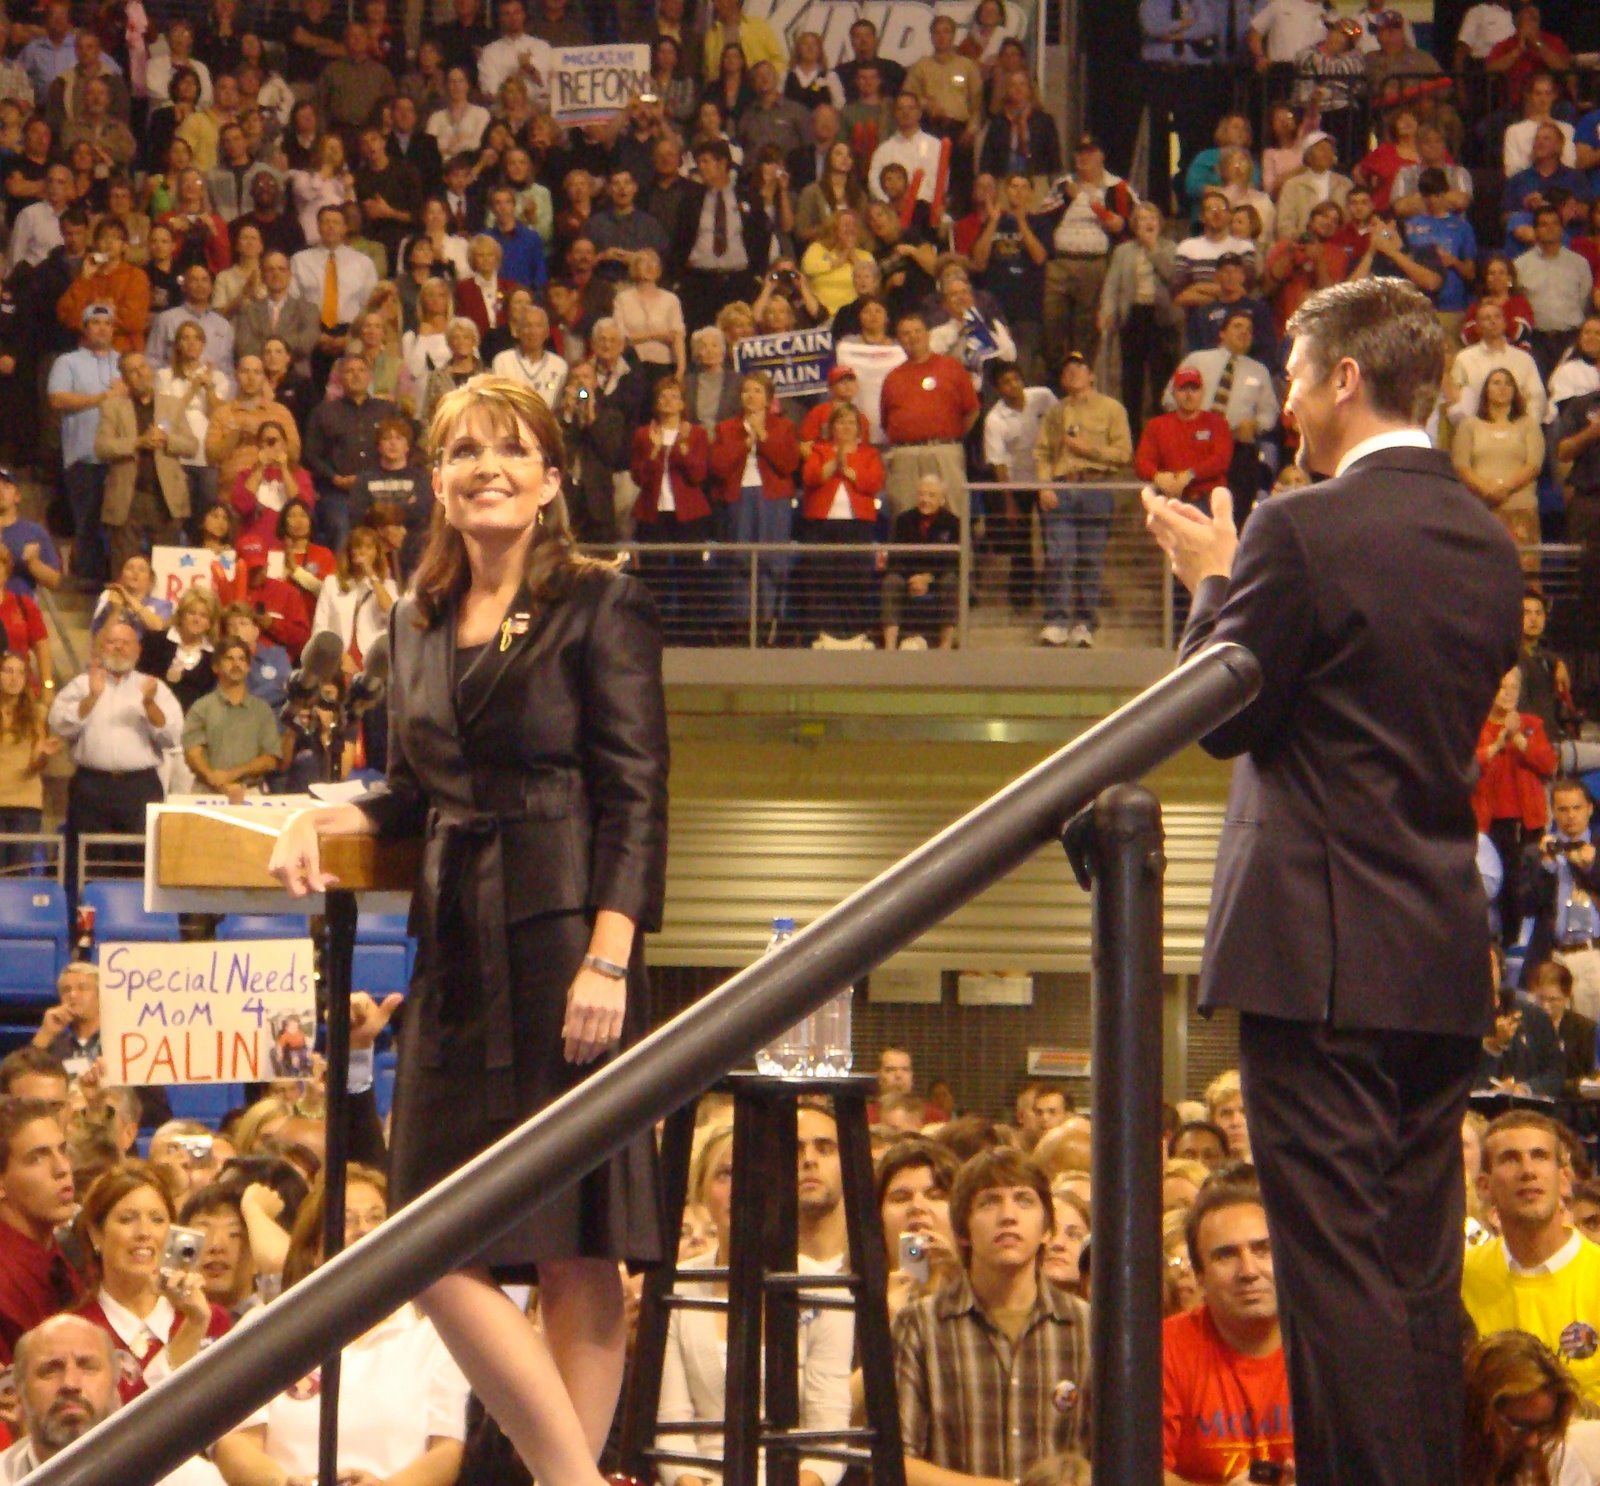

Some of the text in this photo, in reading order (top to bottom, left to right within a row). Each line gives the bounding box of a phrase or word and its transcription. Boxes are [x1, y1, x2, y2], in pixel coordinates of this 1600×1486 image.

[104, 947, 308, 1002] Special Needs
[241, 996, 266, 1028] 4
[120, 1030, 259, 1084] PALIN
